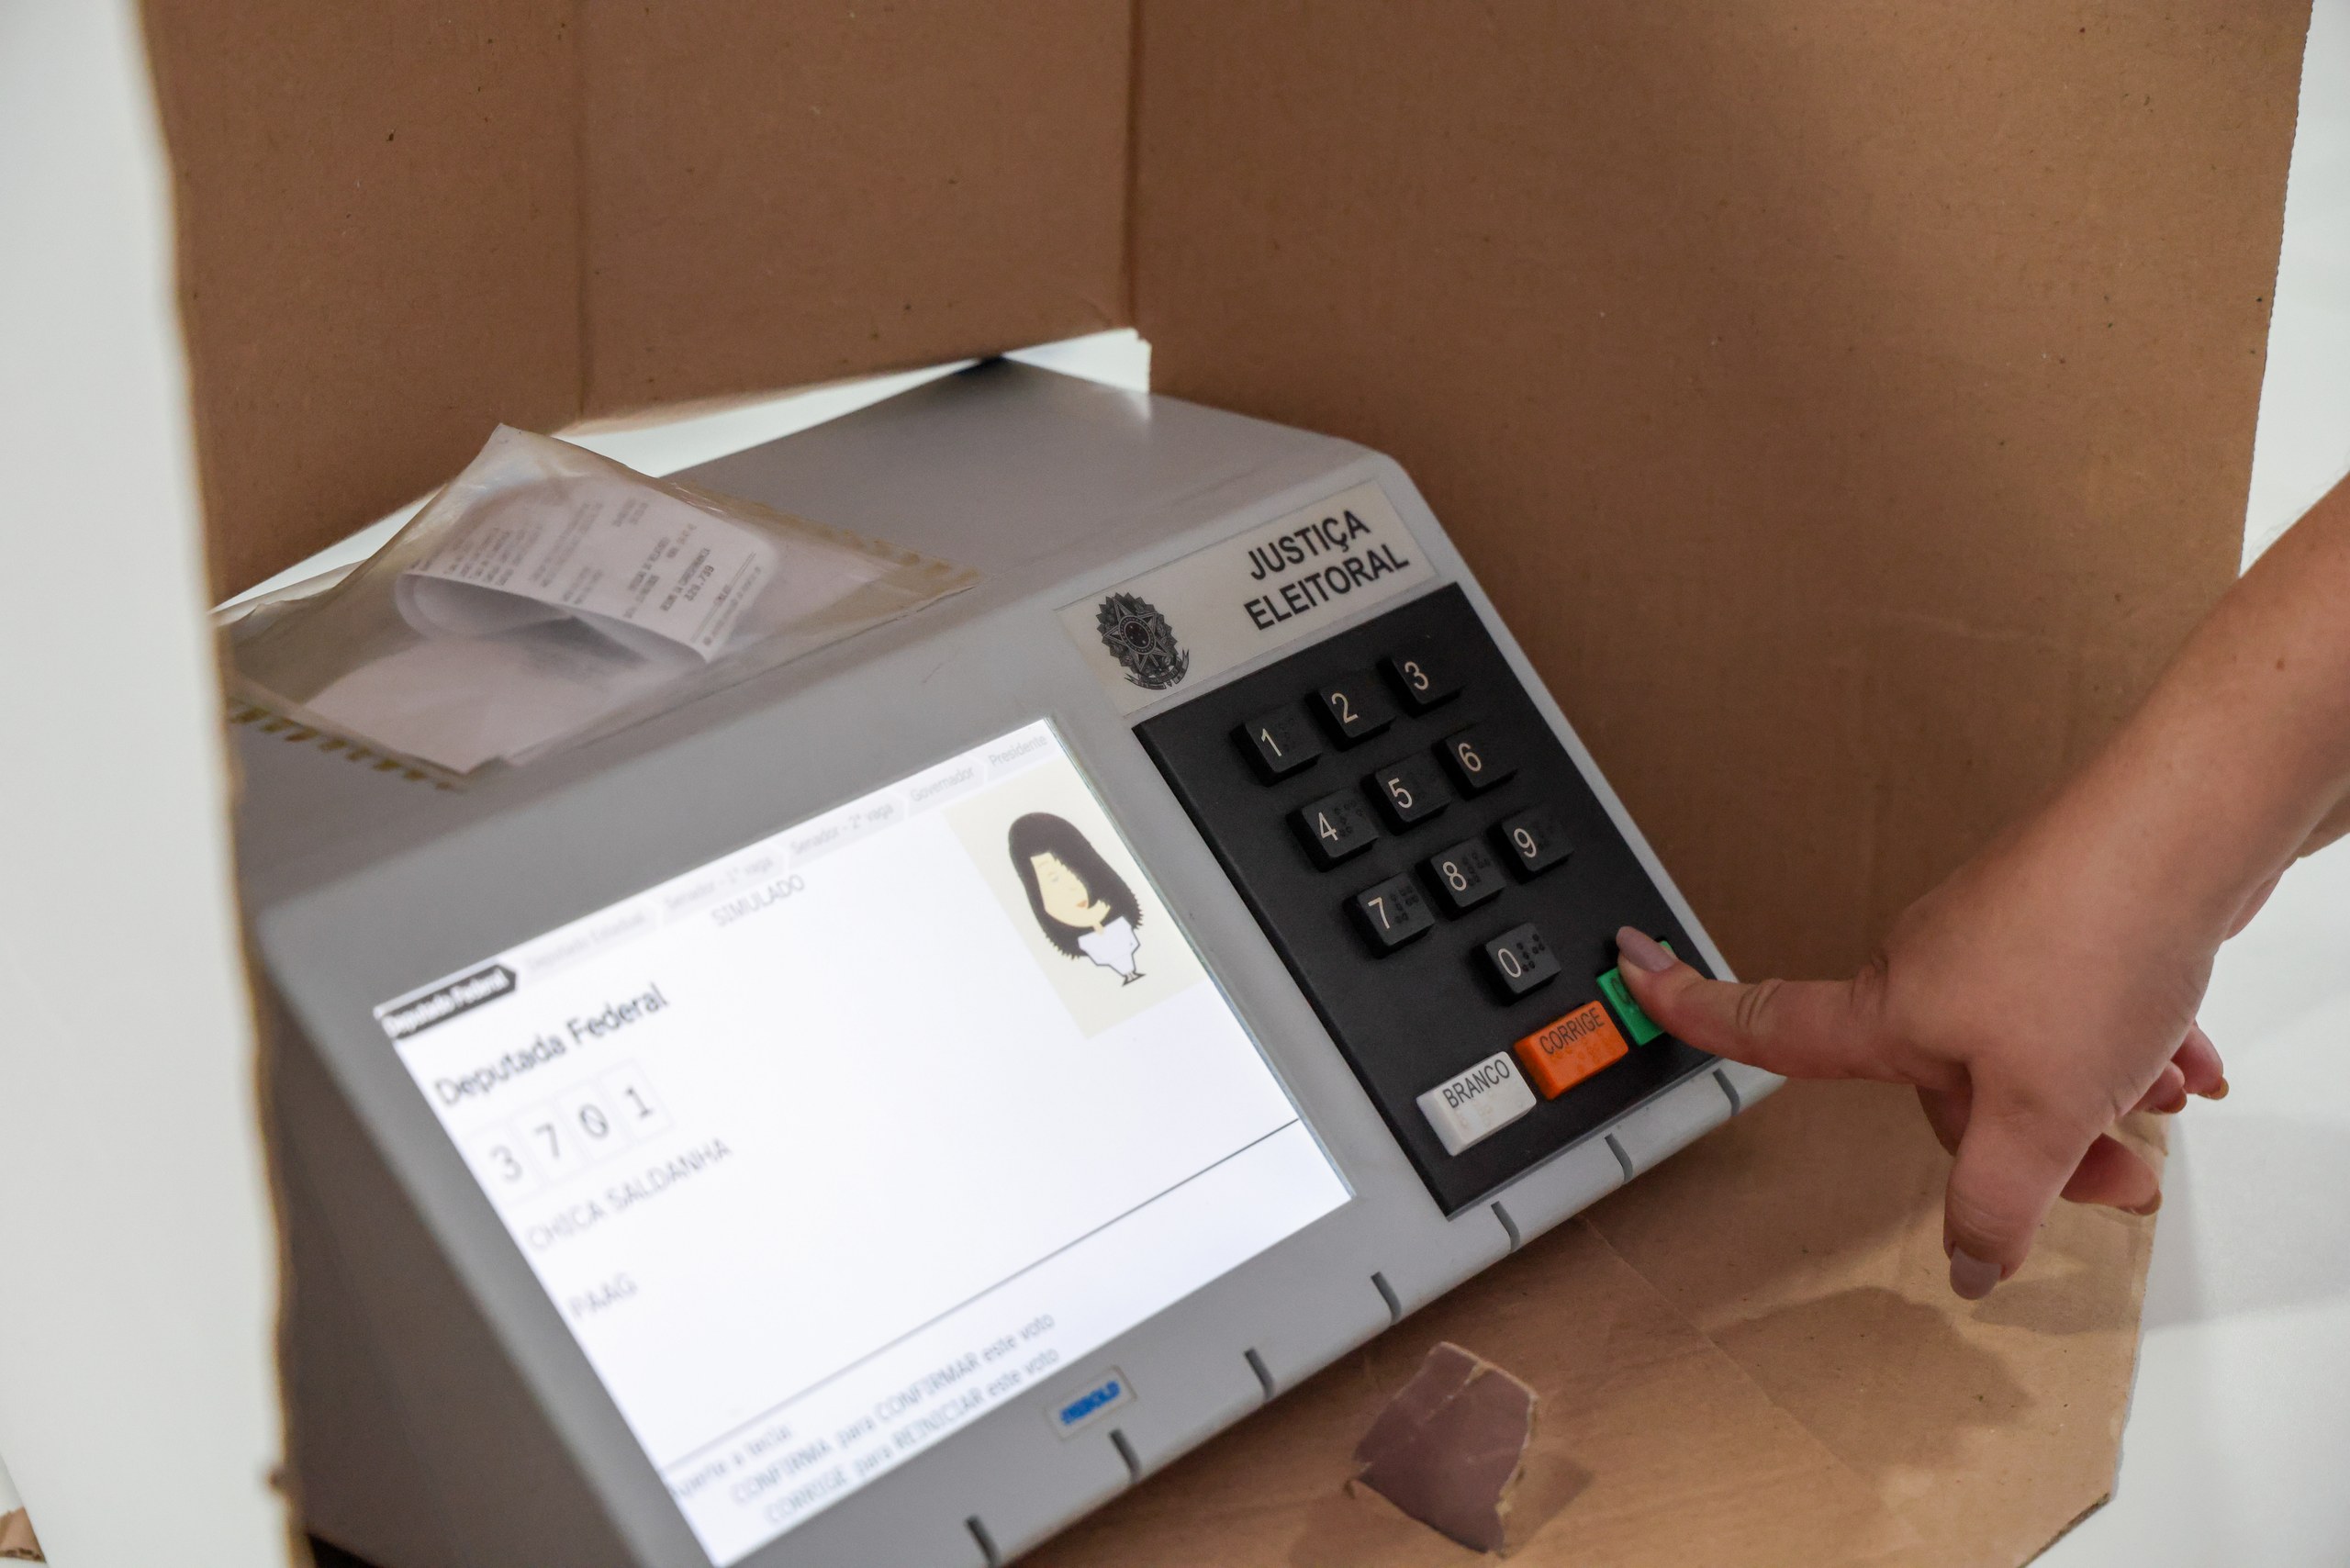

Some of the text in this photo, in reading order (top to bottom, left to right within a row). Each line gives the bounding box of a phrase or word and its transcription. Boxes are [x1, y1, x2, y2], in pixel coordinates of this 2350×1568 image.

[1248, 510, 1371, 581] JUSTIÇA
[1244, 544, 1410, 631] ELEITORAL
[1404, 662, 1429, 690] 3
[1331, 692, 1359, 724] 2
[988, 734, 1047, 767] Presidente
[1260, 728, 1282, 756] 1
[1458, 743, 1482, 772] 6
[911, 765, 974, 802] Governador
[1388, 778, 1414, 809] 5
[1316, 812, 1338, 842] 4
[1513, 828, 1538, 858] 9
[1442, 861, 1468, 891] 8
[711, 874, 805, 927] SIMULADO
[1367, 897, 1392, 929] 7
[1497, 948, 1523, 979] 0
[433, 981, 669, 1107] Deputada Federal
[1539, 1008, 1606, 1057] CORRIGE
[1442, 1058, 1511, 1109] BRANCO
[526, 1137, 733, 1252] CHICA SALDANHA
[874, 1351, 980, 1422] CONFIRMAR
[982, 1335, 1017, 1362] este
[1020, 1314, 1056, 1341] voto
[986, 1369, 1022, 1398] este
[1024, 1348, 1060, 1376] voto
